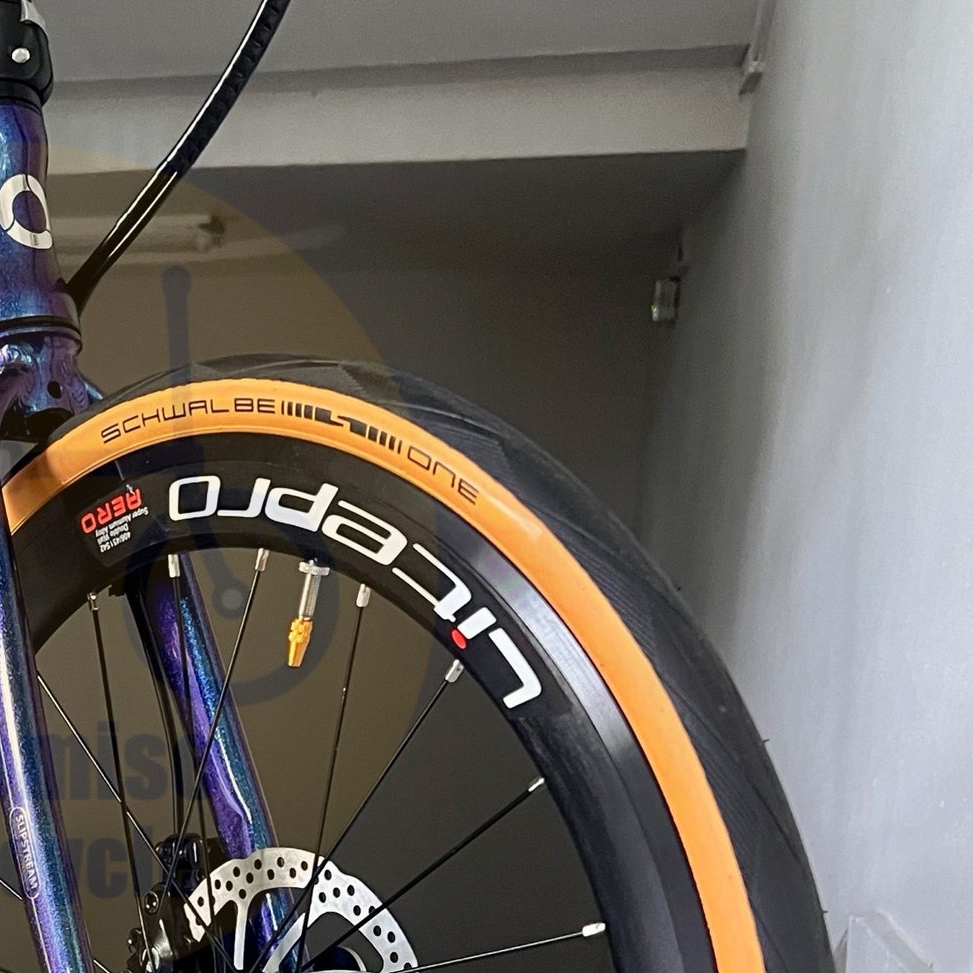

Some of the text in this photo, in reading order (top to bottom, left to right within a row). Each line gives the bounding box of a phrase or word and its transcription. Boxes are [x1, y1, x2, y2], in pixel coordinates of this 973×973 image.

[100, 397, 480, 505] SCHWALBE ONE
[81, 488, 142, 534] AERO
